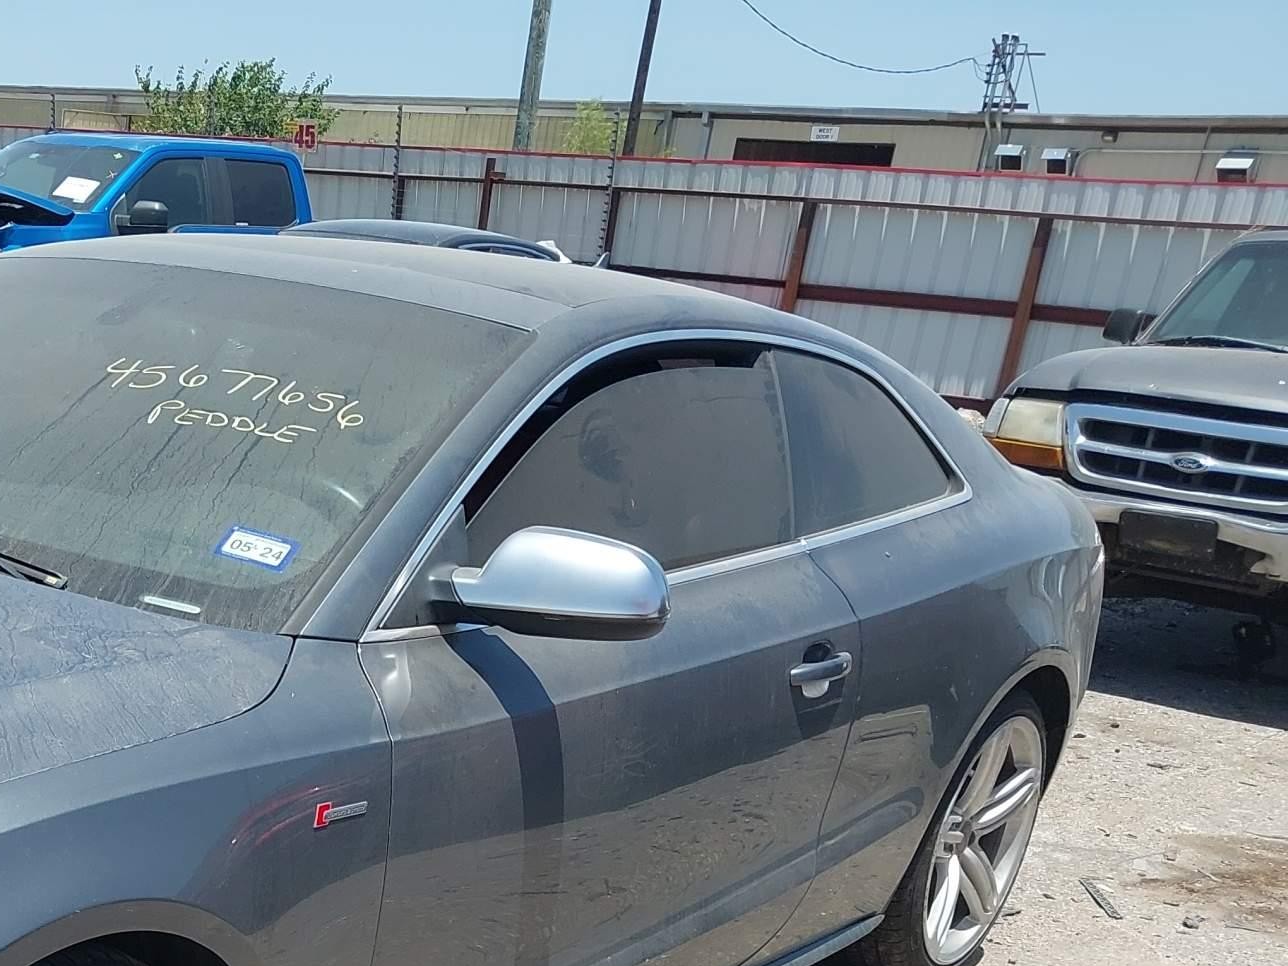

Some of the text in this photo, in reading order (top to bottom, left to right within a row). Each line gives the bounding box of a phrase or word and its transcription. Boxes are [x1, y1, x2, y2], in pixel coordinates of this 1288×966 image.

[294, 124, 316, 149] 45
[146, 399, 318, 443] PEDDLE
[230, 539, 253, 553] 05
[259, 547, 284, 561] 24
